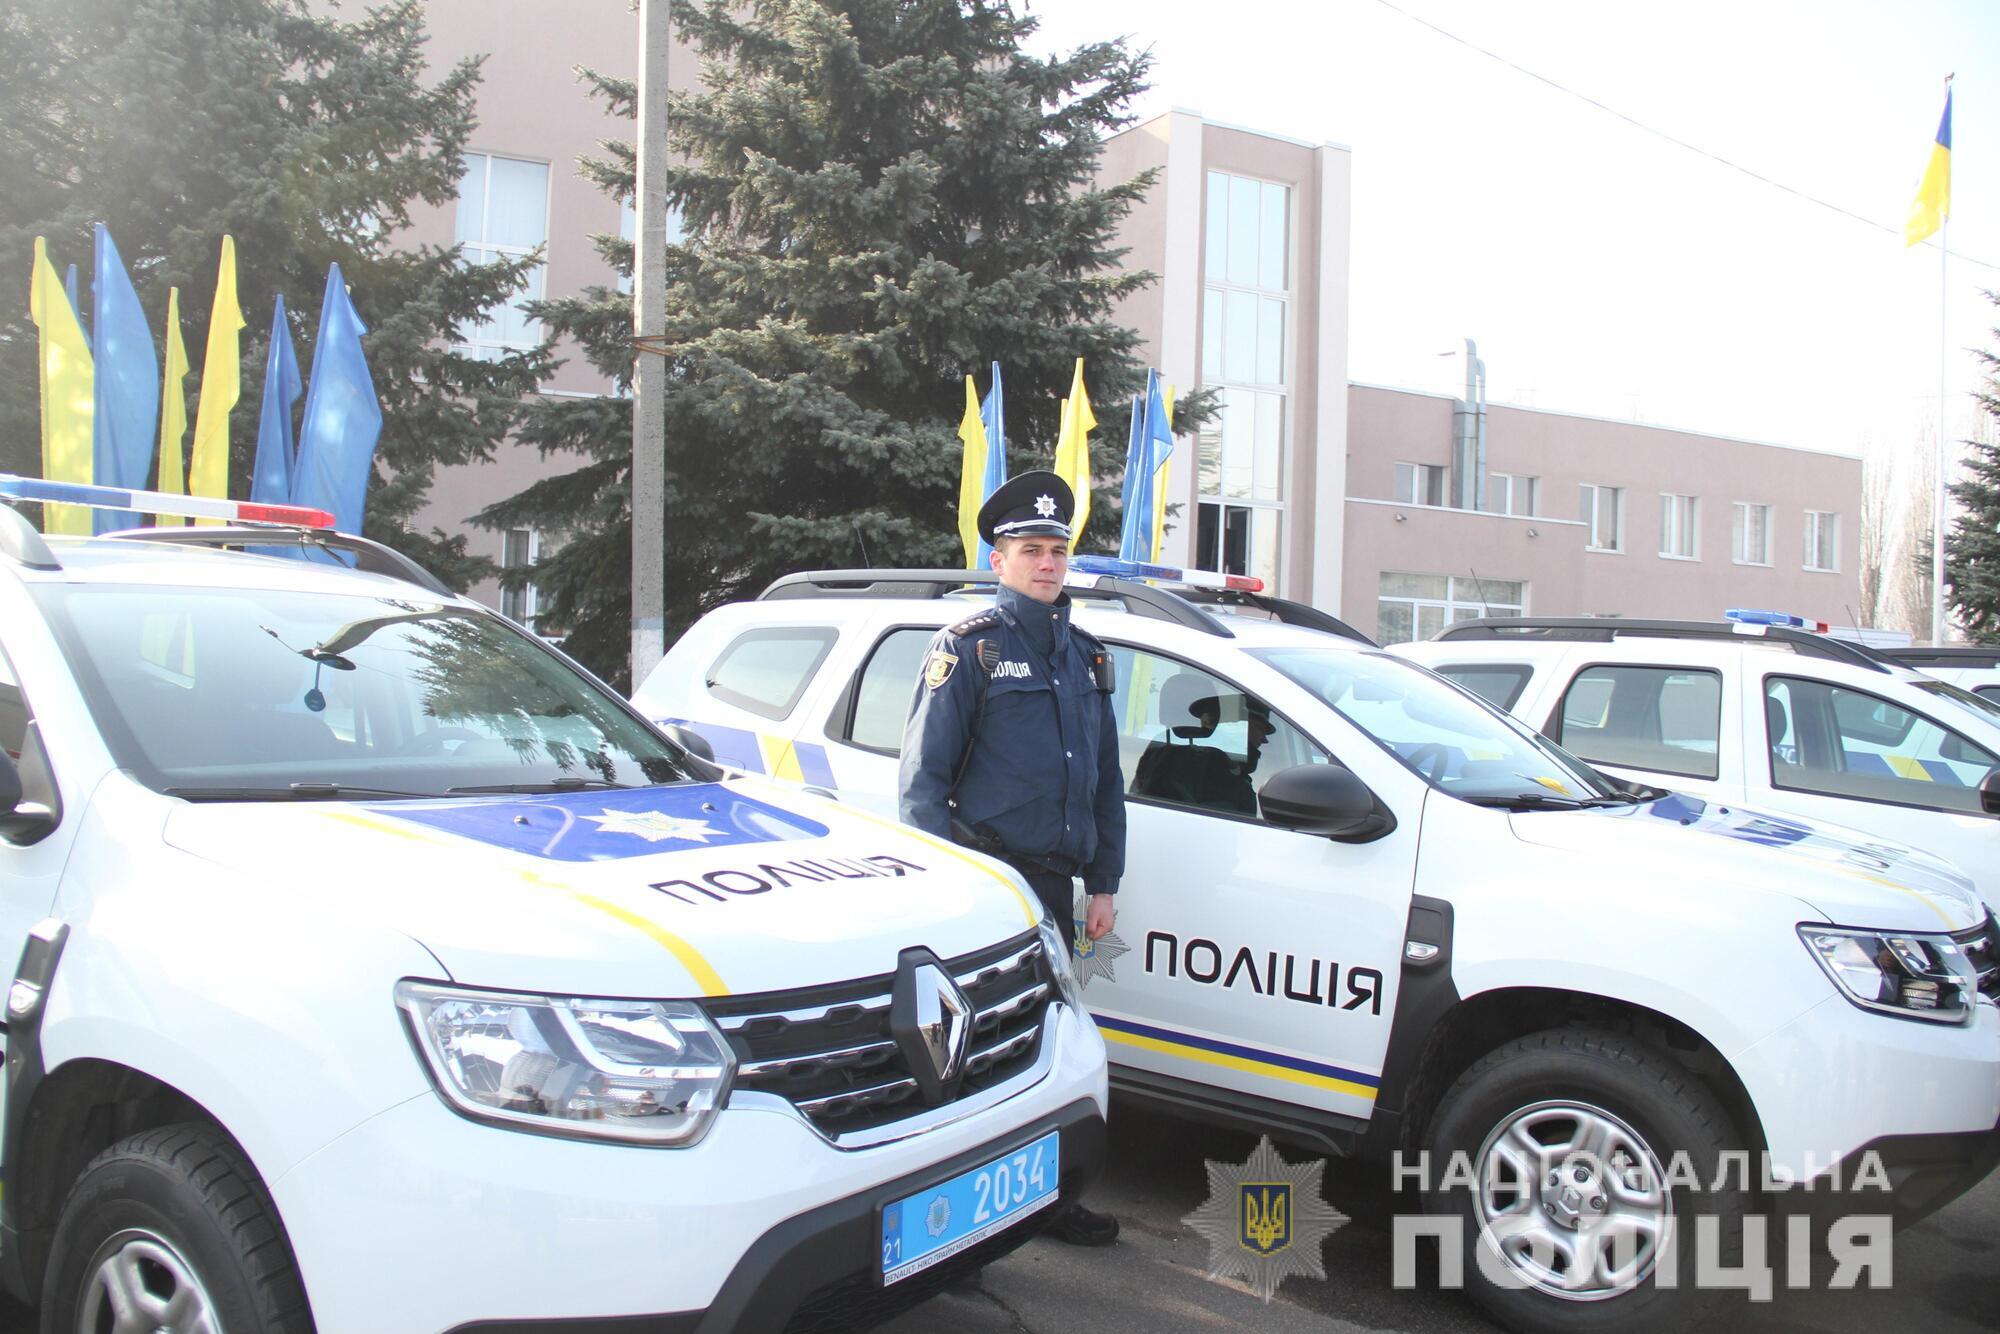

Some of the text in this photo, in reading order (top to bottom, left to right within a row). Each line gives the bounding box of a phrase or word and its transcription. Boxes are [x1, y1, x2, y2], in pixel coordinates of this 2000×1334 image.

[648, 855, 927, 905] ПОЛІЦІЯ
[1145, 930, 1383, 1016] ПОЛІЦІЯ
[973, 1144, 1045, 1225] 2034
[883, 1238, 901, 1265] 21
